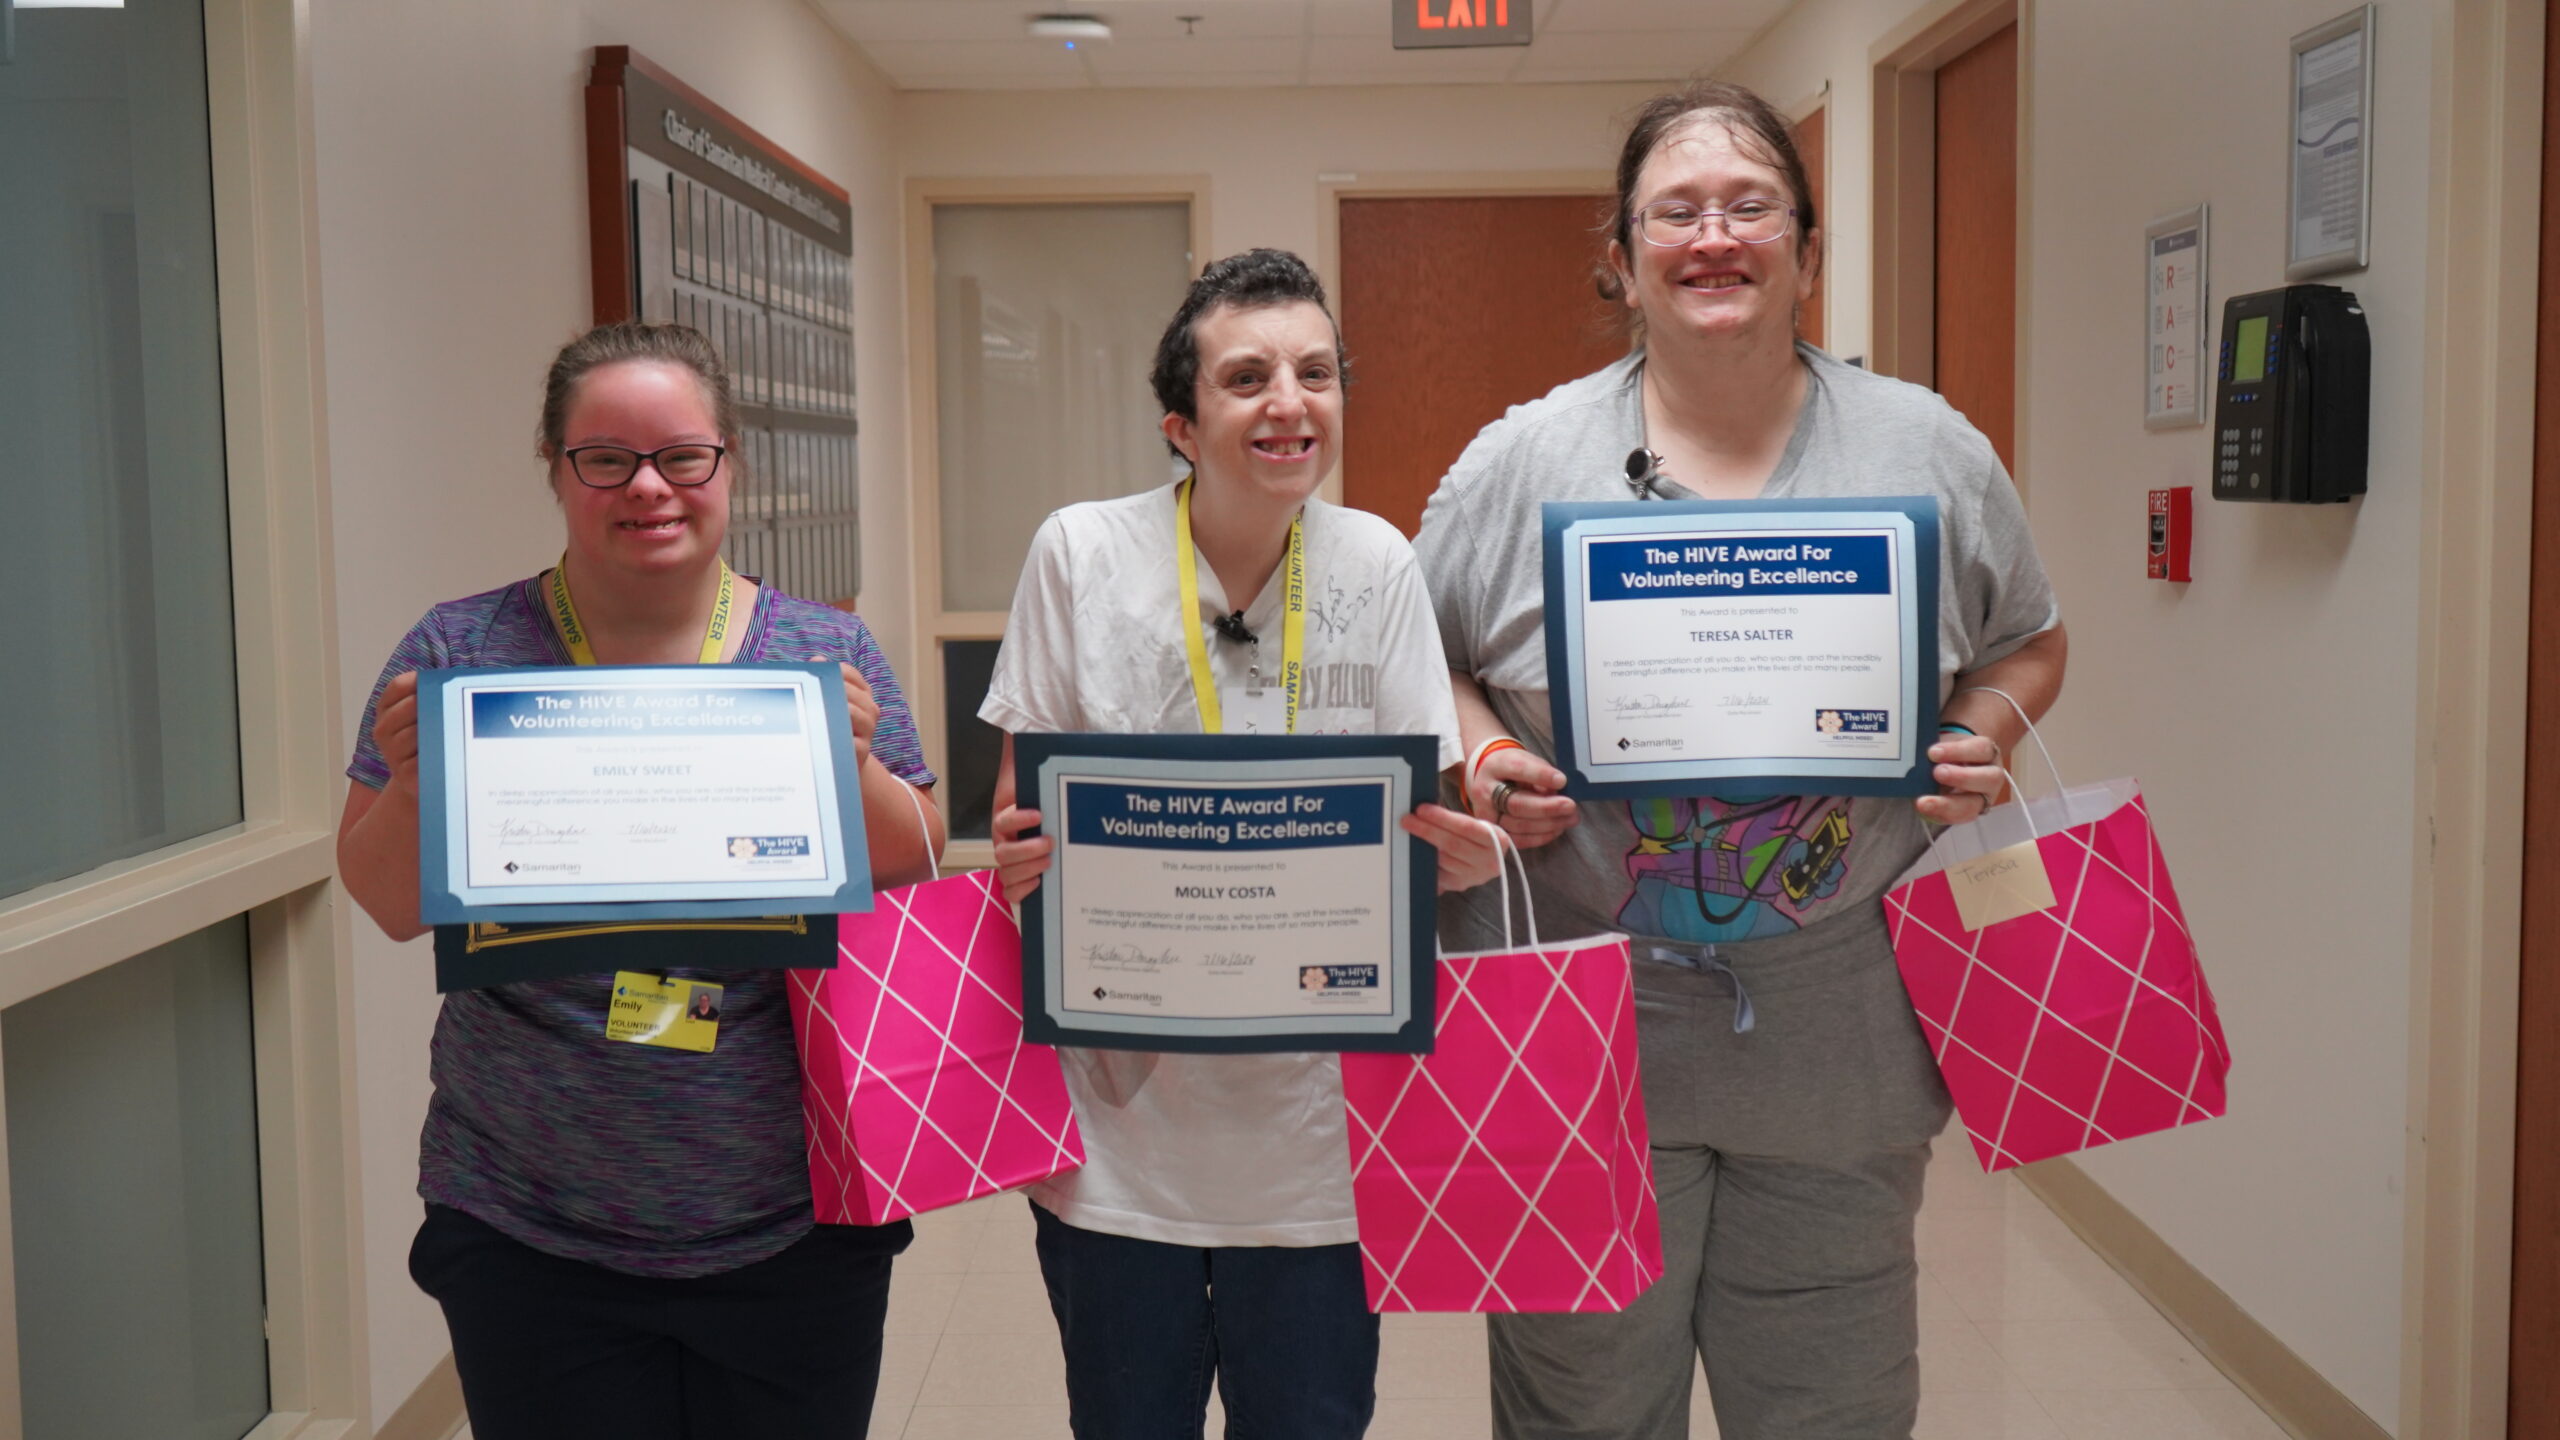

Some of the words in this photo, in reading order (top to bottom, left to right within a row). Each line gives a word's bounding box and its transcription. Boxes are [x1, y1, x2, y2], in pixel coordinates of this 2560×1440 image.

[2166, 265, 2174, 289] R
[2166, 306, 2174, 329] A
[2166, 345, 2175, 370] C
[2166, 386, 2174, 409] E
[2150, 492, 2168, 512] FIRE
[1645, 548, 1679, 564] The
[1684, 546, 1729, 563] HIVE
[1734, 545, 1797, 562] Award
[1802, 545, 1832, 561] For
[1289, 530, 1303, 613] VOLUNTEER
[1621, 569, 1744, 589] Volunteering
[1749, 568, 1858, 584] Excellence
[1680, 608, 1697, 616] This
[1698, 608, 1729, 617] Award
[1731, 608, 1738, 616] is
[1739, 607, 1787, 616] presented
[1788, 607, 1799, 615] to
[1690, 630, 1741, 642] TERESA
[1744, 629, 1794, 641] SALTER
[1612, 659, 1635, 669] deep
[1637, 656, 1691, 667] appreciation
[1716, 656, 1732, 665] you
[1770, 655, 1787, 665] you
[1806, 654, 1824, 663] and
[1826, 653, 1840, 662] the
[1842, 652, 1882, 663] incredibly
[1610, 666, 1658, 678] meaningful
[1660, 665, 1701, 676] difference
[1702, 666, 1720, 676] you
[1721, 664, 1746, 673] make
[1757, 663, 1771, 672] the
[1814, 663, 1838, 673] many
[535, 696, 572, 710] The
[580, 695, 626, 710] HIVE
[633, 695, 699, 708] Award
[706, 694, 736, 708] For
[1286, 661, 1299, 735] SAMARIT
[509, 714, 643, 730] Volunteering
[651, 712, 765, 727] Excellence
[1843, 712, 1860, 721] The
[1861, 712, 1886, 722] HIVE
[1850, 722, 1879, 731] Award
[1632, 737, 1684, 748] Samaritan
[593, 765, 638, 777] EMILY
[643, 763, 692, 776] SWEET
[1126, 794, 1162, 812] The
[1168, 796, 1215, 815] HIVE
[1220, 796, 1287, 815] Award
[1293, 795, 1324, 812] For
[1101, 817, 1230, 844] Volunteering
[1236, 820, 1350, 839] Excellence
[759, 838, 776, 848] The
[777, 837, 804, 847] HIVE
[767, 847, 798, 856] Award
[522, 862, 581, 873] Samaritan
[1162, 861, 1179, 871] This
[1181, 863, 1212, 872] Award
[1215, 864, 1221, 872] is
[1223, 863, 1273, 873] presented
[1276, 862, 1287, 871] to
[1954, 859, 2020, 885] Teresa
[1175, 886, 1225, 899] MOLLY
[1228, 886, 1276, 899] COSTA
[1090, 907, 1114, 917] deep
[1116, 910, 1174, 921] appreciation
[1198, 913, 1214, 923] you
[1254, 912, 1271, 922] you
[1292, 909, 1310, 919] and
[1312, 908, 1327, 917] the
[1329, 906, 1371, 918] incredibly
[1139, 919, 1182, 930] difference
[1203, 922, 1229, 931] make
[1328, 967, 1347, 977] The
[1348, 966, 1375, 977] HIVE
[1337, 977, 1367, 986] Award
[629, 988, 669, 1001] Samaritan
[1108, 989, 1162, 1002] Samaritan
[614, 998, 643, 1013] Emily
[610, 1018, 661, 1032] VOLUNTEER
